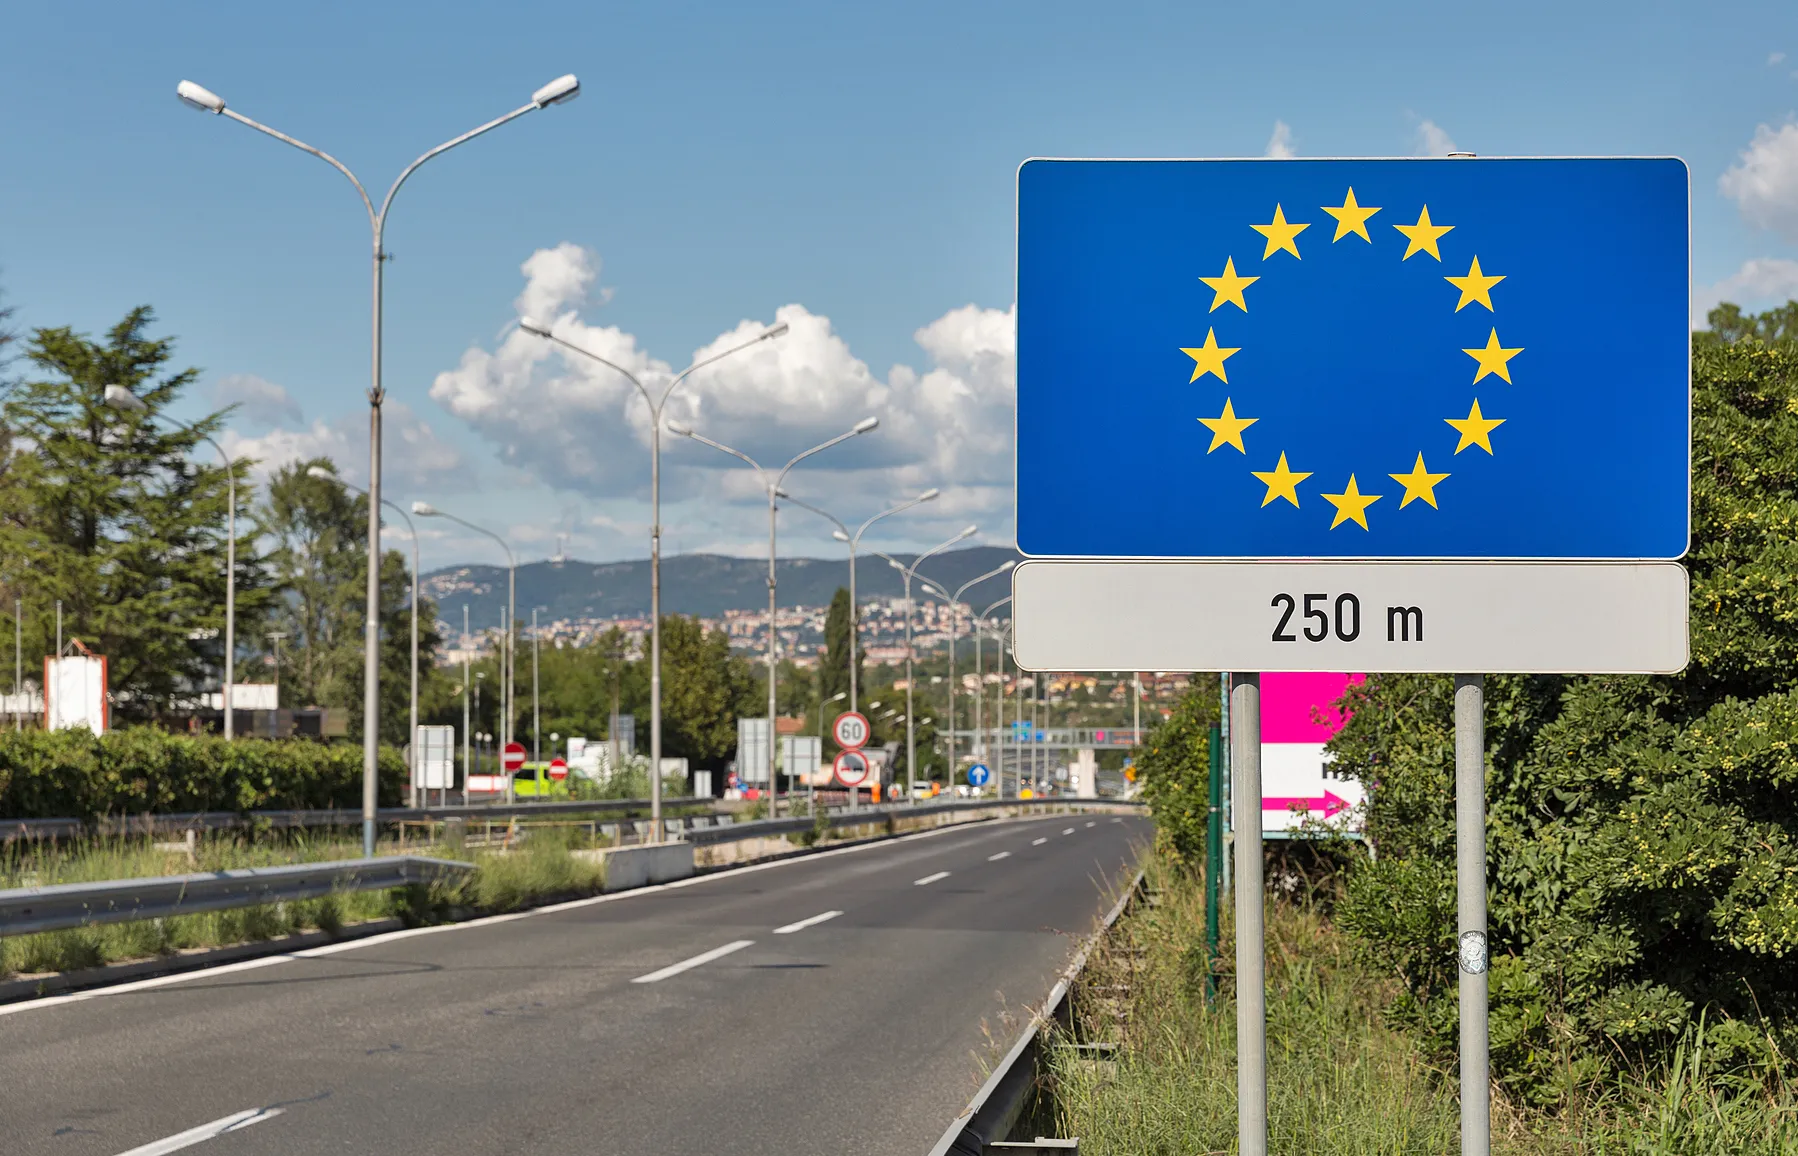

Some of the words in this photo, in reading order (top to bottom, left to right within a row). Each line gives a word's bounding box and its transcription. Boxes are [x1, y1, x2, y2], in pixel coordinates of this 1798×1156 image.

[1271, 592, 1361, 642] 250
[1387, 606, 1424, 642] m
[842, 722, 862, 741] 60
